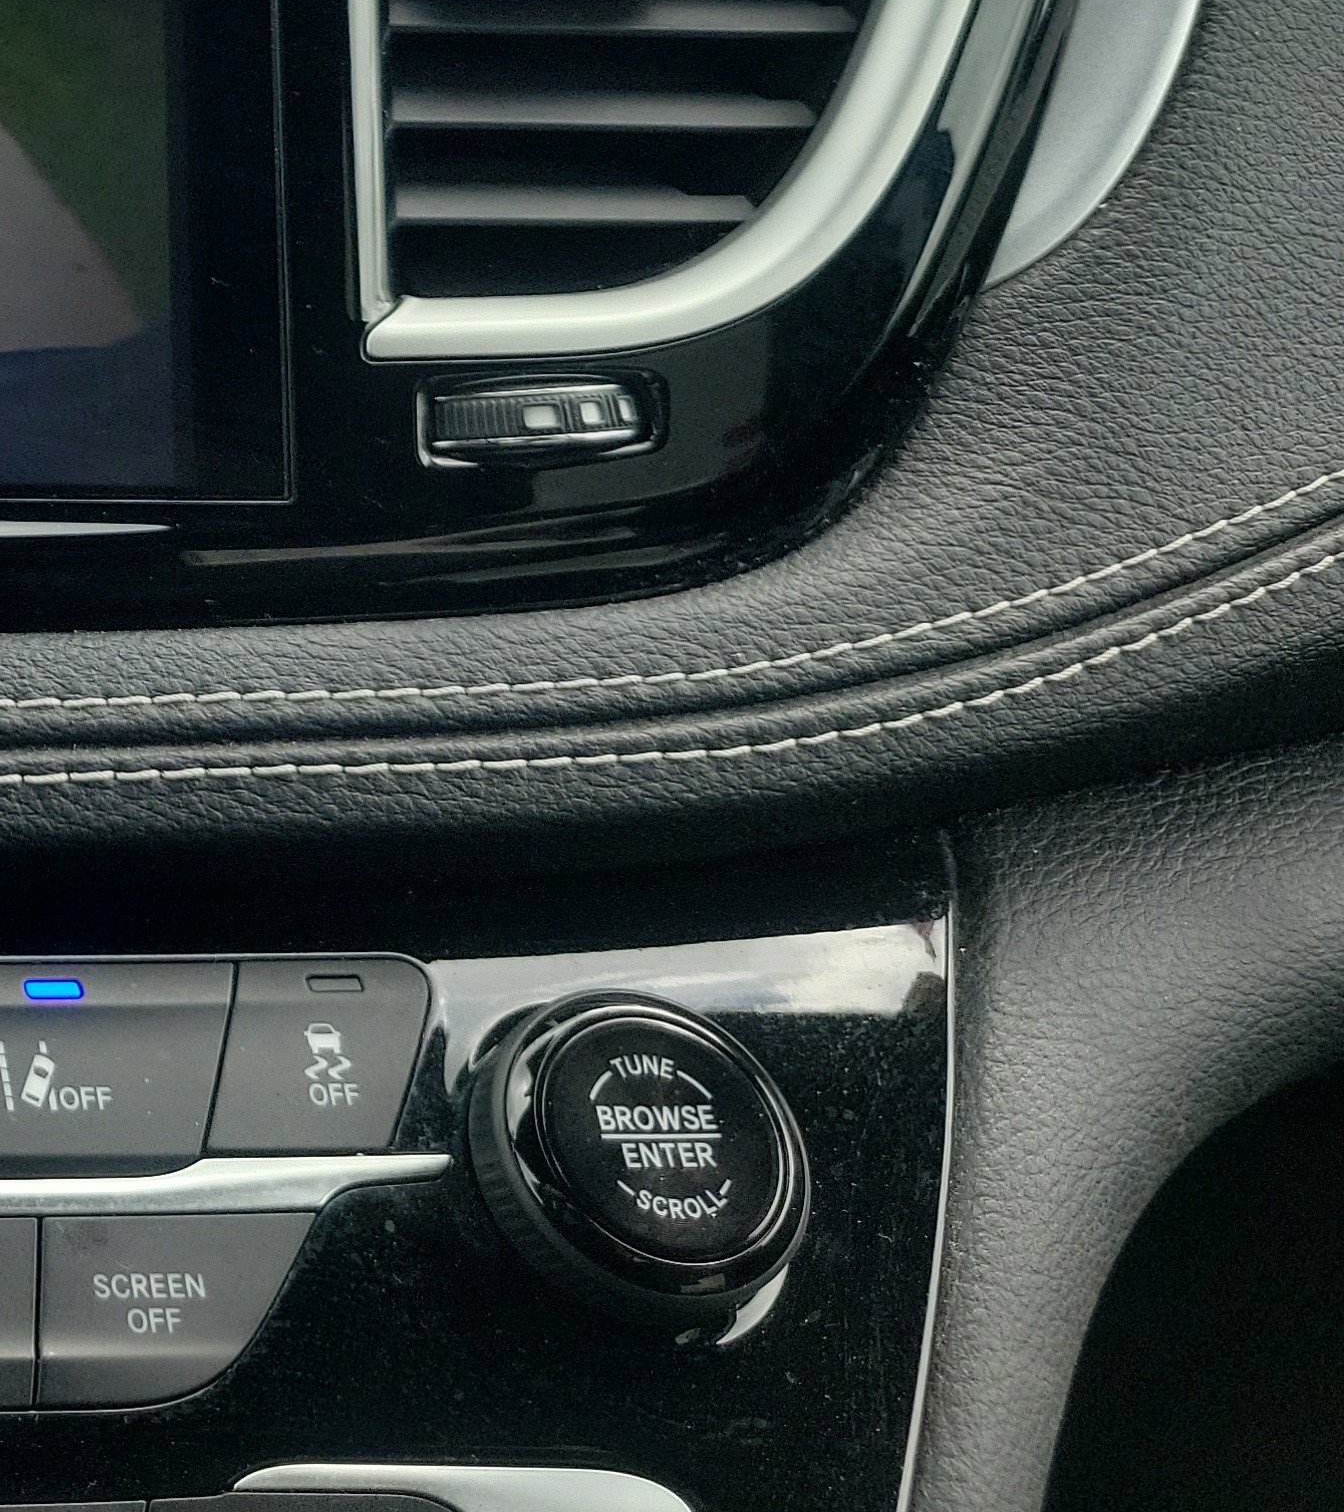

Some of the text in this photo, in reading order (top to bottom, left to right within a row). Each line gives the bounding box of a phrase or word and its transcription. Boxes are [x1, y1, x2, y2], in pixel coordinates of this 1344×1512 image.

[609, 1054, 677, 1081] TUNE
[59, 1085, 113, 1111] OFF
[308, 1081, 361, 1107] OFF
[595, 1104, 719, 1131] BROWSE
[620, 1141, 718, 1169] ENTER
[635, 1188, 728, 1219] SCROLL
[92, 1272, 208, 1301] SCREEN
[126, 1307, 183, 1336] OFF
